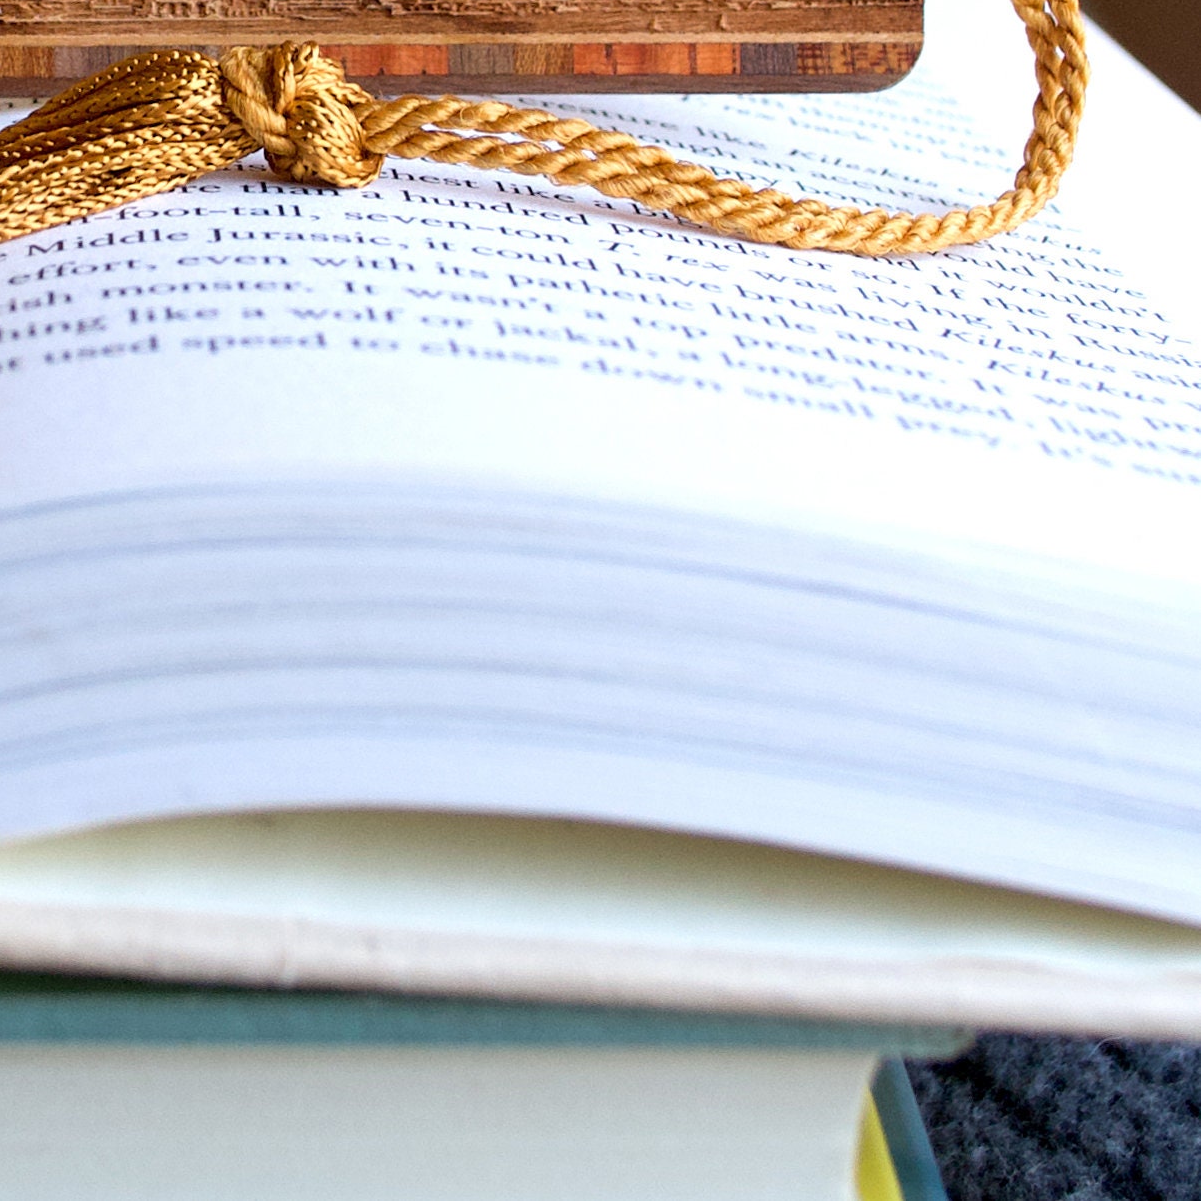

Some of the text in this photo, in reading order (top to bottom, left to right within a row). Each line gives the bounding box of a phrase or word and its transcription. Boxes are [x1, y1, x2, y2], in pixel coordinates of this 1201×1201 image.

[27, 228, 190, 257] Middle
[205, 228, 410, 250] Jurassic,
[423, 237, 456, 252] it
[471, 246, 600, 273] could
[614, 262, 724, 294] have
[733, 284, 921, 333] brushed
[940, 327, 1118, 374] Kileskus
[128, 305, 220, 325] like
[241, 307, 266, 319] a
[287, 306, 404, 324] wolf
[419, 314, 473, 329] or
[239, 181, 343, 198] than
[361, 189, 385, 201] a
[400, 189, 591, 227] hundred
[606, 222, 772, 260] pounds
[787, 256, 832, 272] or
[850, 269, 912, 290] so.
[927, 283, 965, 300] If
[980, 297, 1051, 319] the
[1065, 312, 1193, 345] forty-
[344, 211, 572, 245] seven-ton
[598, 239, 641, 257] T.
[664, 253, 729, 272] rex
[748, 268, 838, 293] was
[853, 286, 994, 330] living
[1005, 320, 1054, 340] in
[492, 180, 575, 204] like
[593, 199, 618, 211] a
[871, 255, 922, 272] nd
[937, 266, 970, 283] it
[980, 279, 1171, 324] wouldn't
[929, 251, 1147, 300] ould have
[1059, 257, 1125, 278] the
[7, 259, 159, 286] effort,
[176, 255, 290, 266] even
[310, 256, 416, 273] with
[435, 261, 490, 280] its
[506, 273, 696, 311] pathetic
[708, 302, 817, 334] little
[835, 329, 965, 364] arms.
[986, 359, 1167, 405] Kileskus
[43, 333, 160, 366] used
[179, 330, 328, 355] speed
[350, 336, 401, 350] to
[418, 337, 561, 367] chase
[578, 355, 725, 394] down
[101, 280, 315, 299] monster.
[344, 281, 378, 296] It
[403, 286, 554, 313] wasn't
[583, 308, 607, 321] a
[630, 316, 710, 340] top
[732, 333, 947, 385] predator.
[1031, 393, 1123, 420] was
